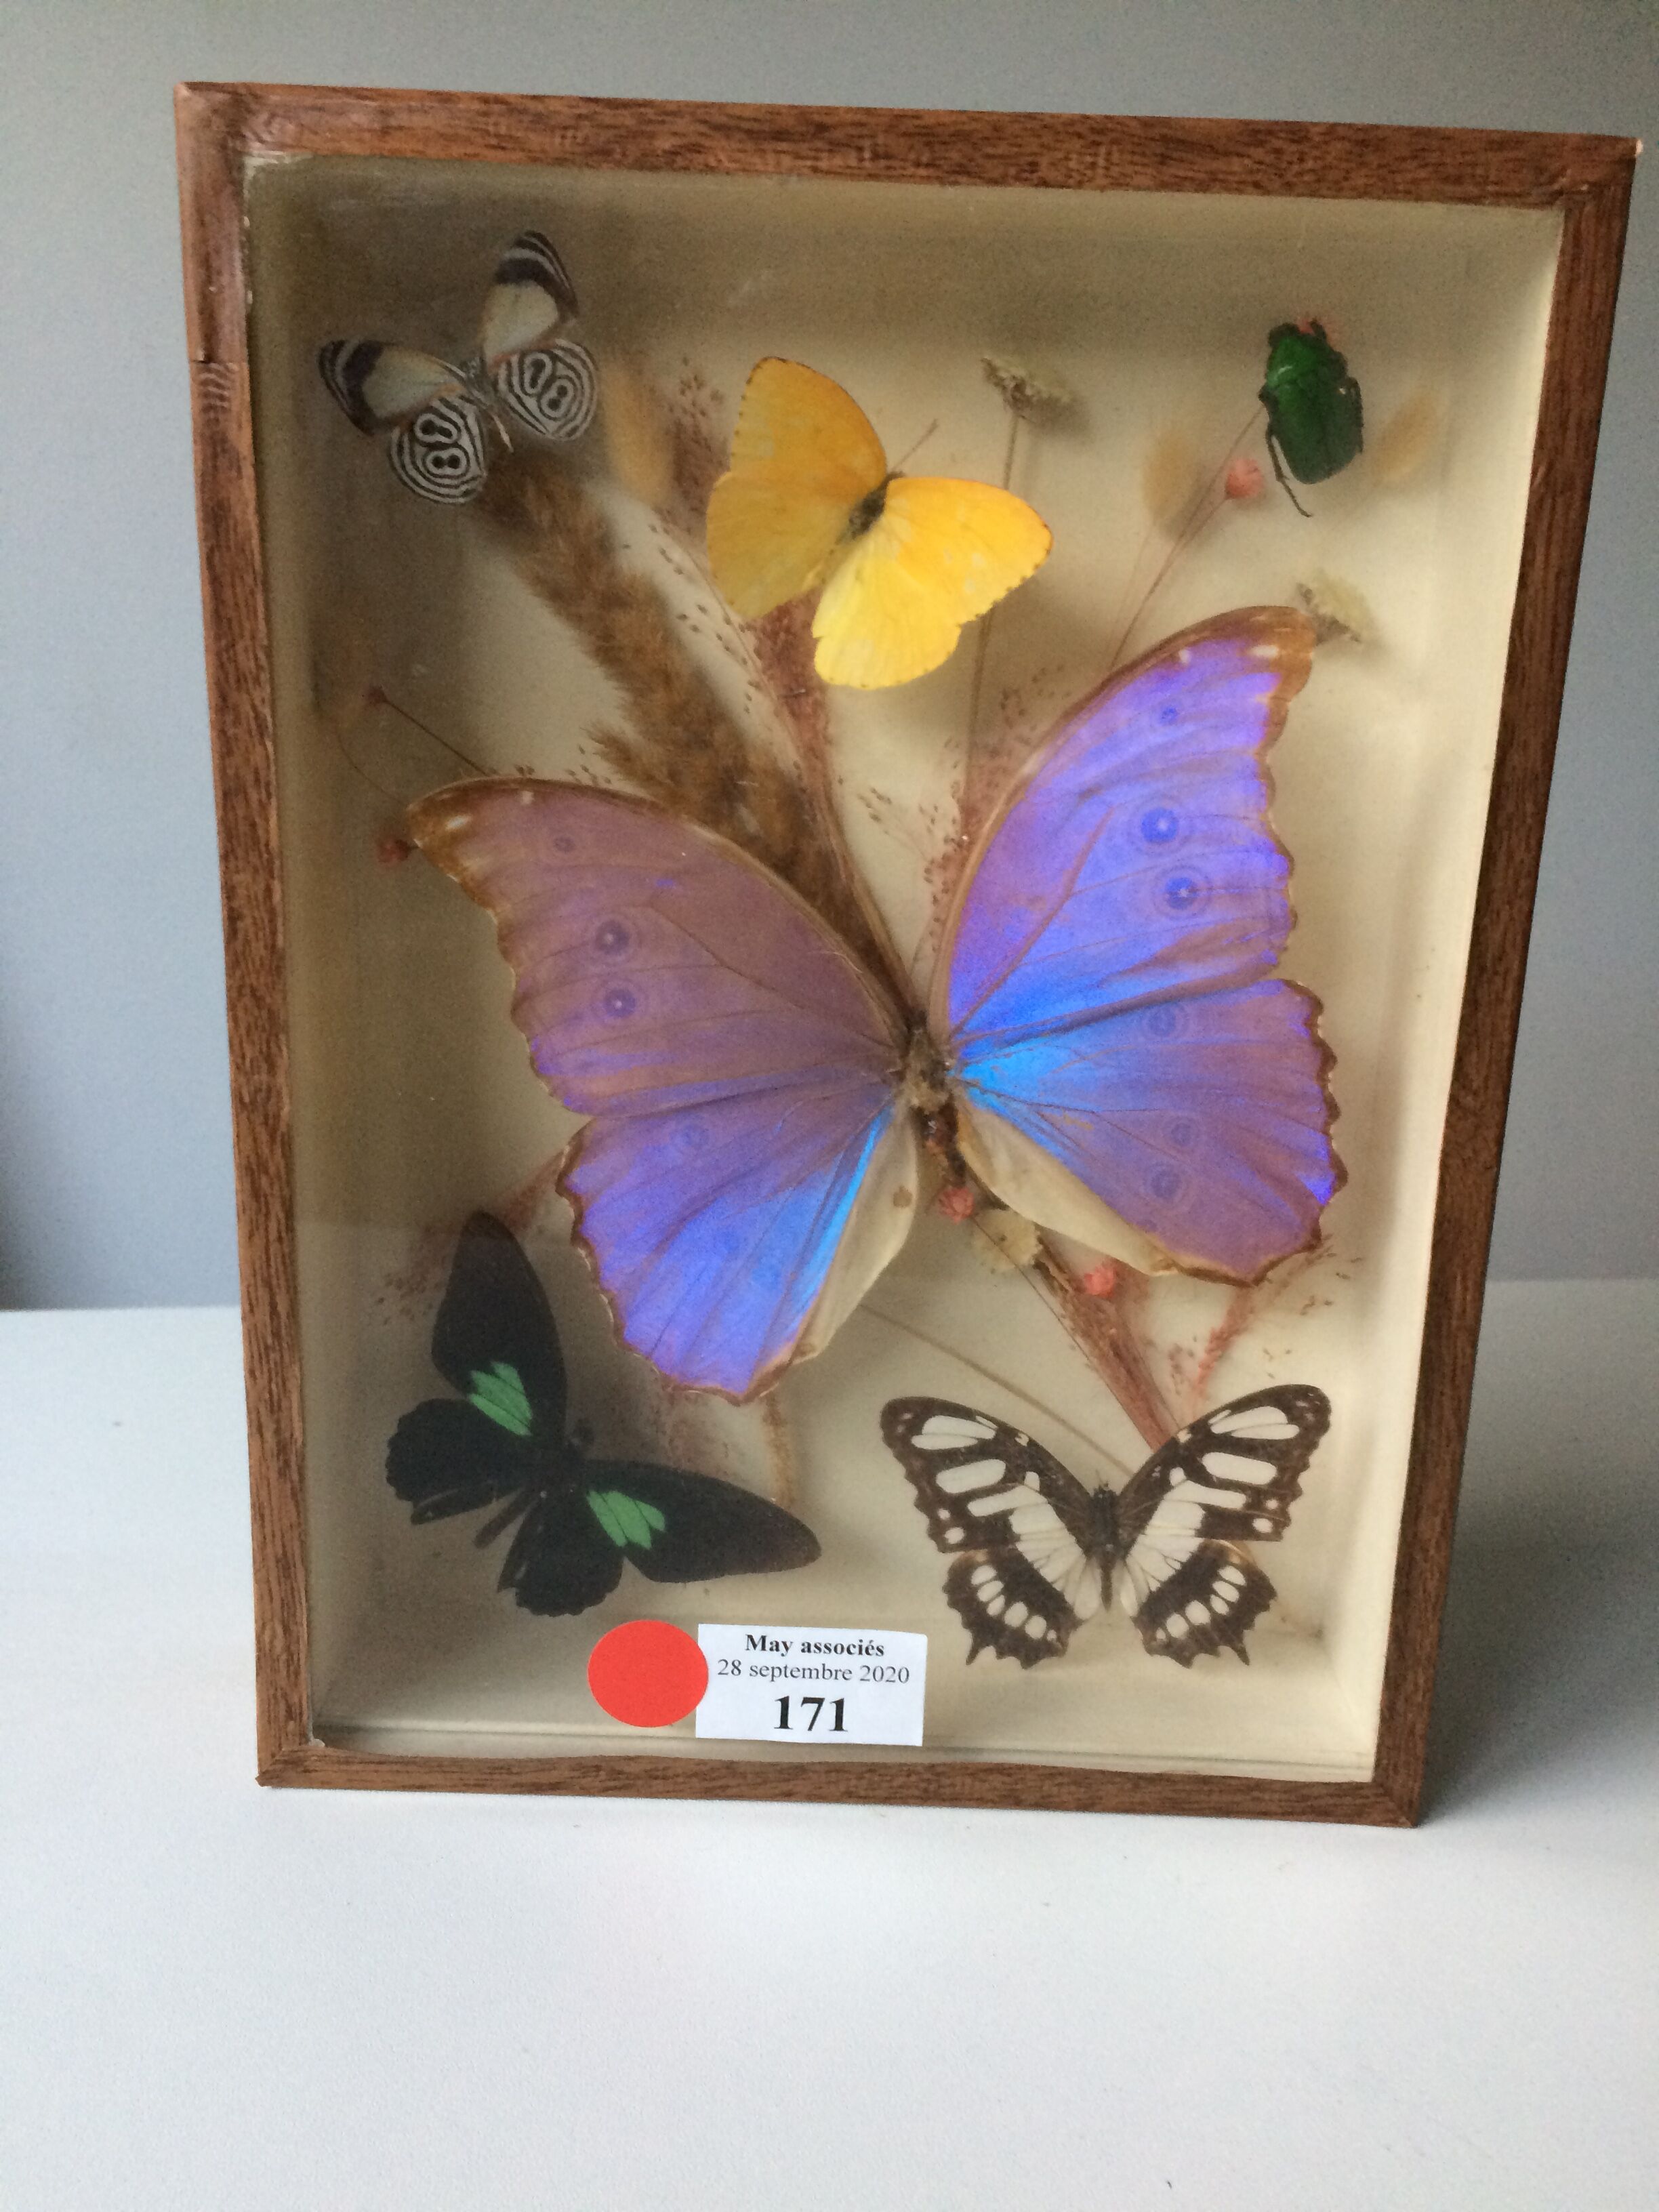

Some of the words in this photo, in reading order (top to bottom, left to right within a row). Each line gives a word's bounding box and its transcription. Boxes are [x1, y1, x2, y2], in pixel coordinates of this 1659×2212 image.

[745, 1634, 793, 1657] May
[800, 1639, 884, 1656] associés
[717, 1659, 742, 1676] 28
[749, 1663, 853, 1682] septembre
[859, 1665, 910, 1683] 2020
[774, 1696, 848, 1732] 171
